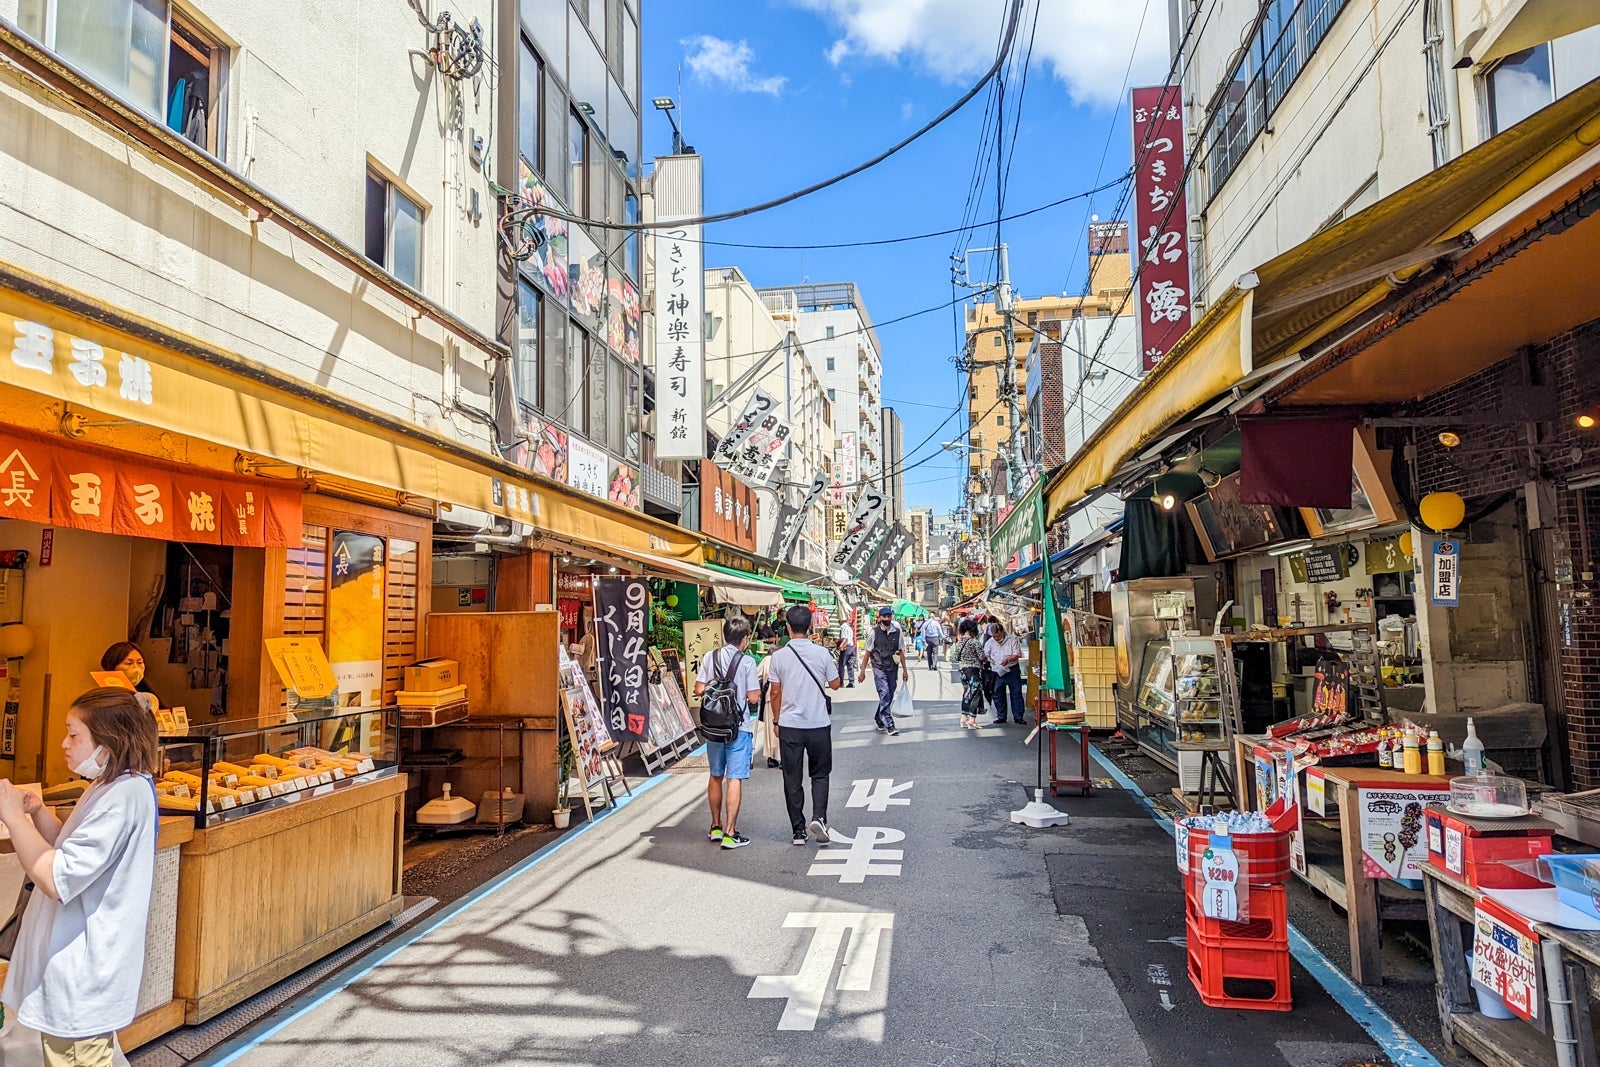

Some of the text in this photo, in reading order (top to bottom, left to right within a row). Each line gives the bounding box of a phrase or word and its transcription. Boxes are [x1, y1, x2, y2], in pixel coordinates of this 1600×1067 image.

[667, 229, 692, 398] つきぢ神楽寿司
[669, 407, 689, 440] 新館
[69, 472, 216, 533] 玉子焼
[236, 503, 248, 535] 山長
[1438, 557, 1452, 597] 加盟店
[603, 605, 626, 731] くじらの日
[623, 582, 647, 706] 9月4日は
[1208, 867, 1235, 882] ¥200
[746, 778, 914, 1031] 止まれ
[1474, 934, 1536, 989] おでん盛り合わせ
[1493, 928, 1517, 952] おでん
